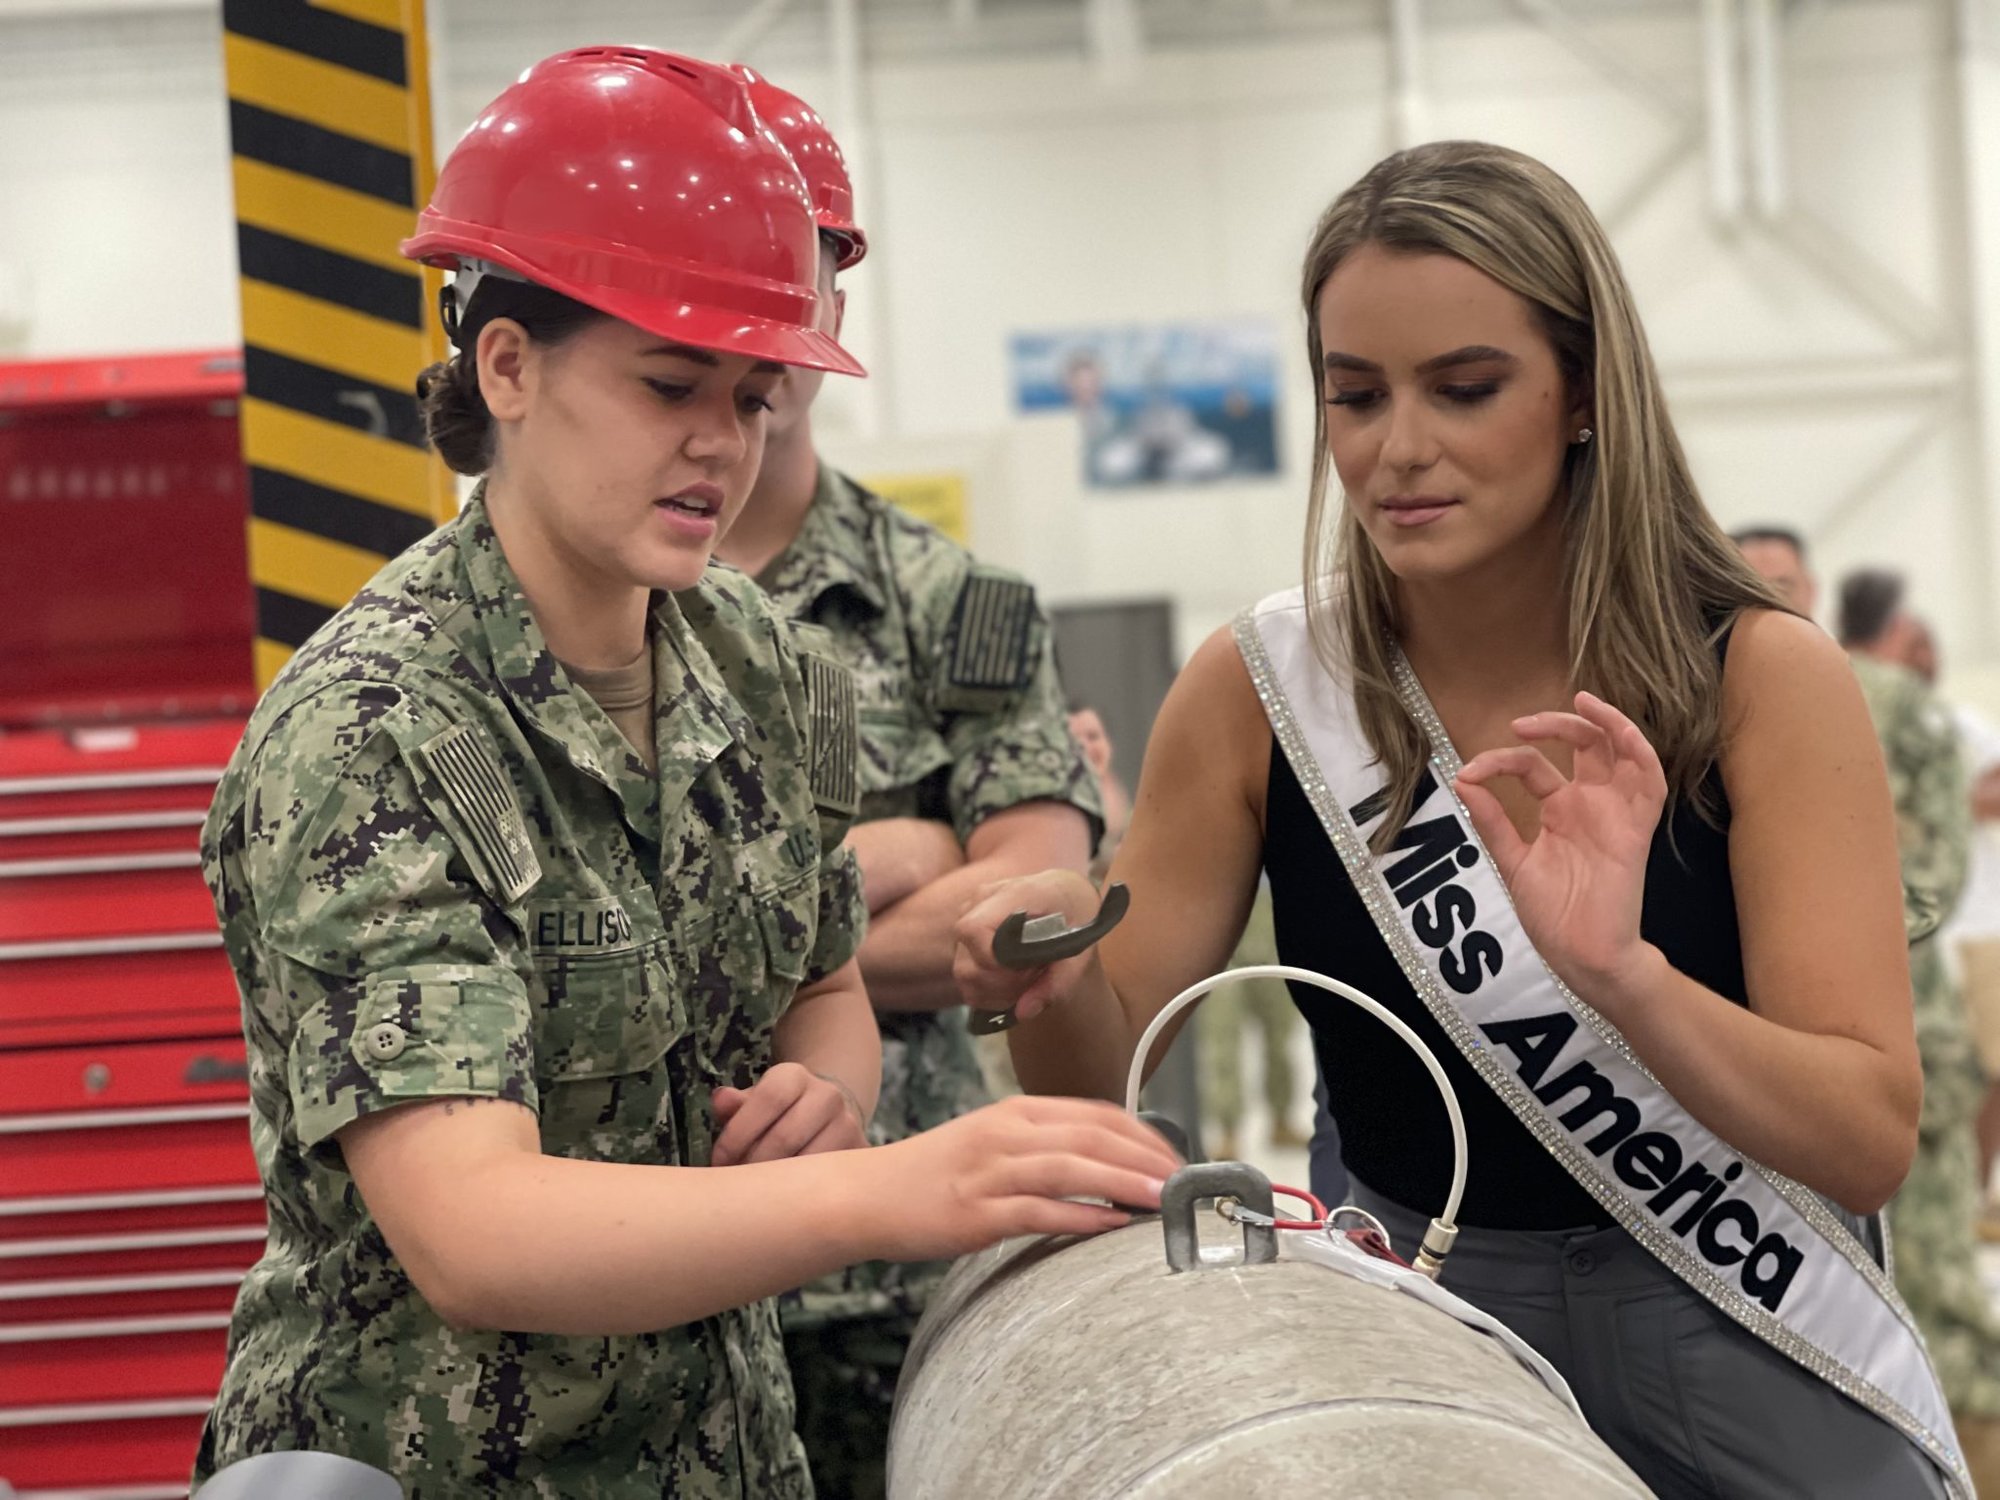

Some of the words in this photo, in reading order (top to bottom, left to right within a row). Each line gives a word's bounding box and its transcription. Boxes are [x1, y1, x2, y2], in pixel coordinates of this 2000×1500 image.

[538, 905, 632, 946] ELLISO
[1349, 766, 1504, 995] Miss
[1478, 1011, 1805, 1313] America
